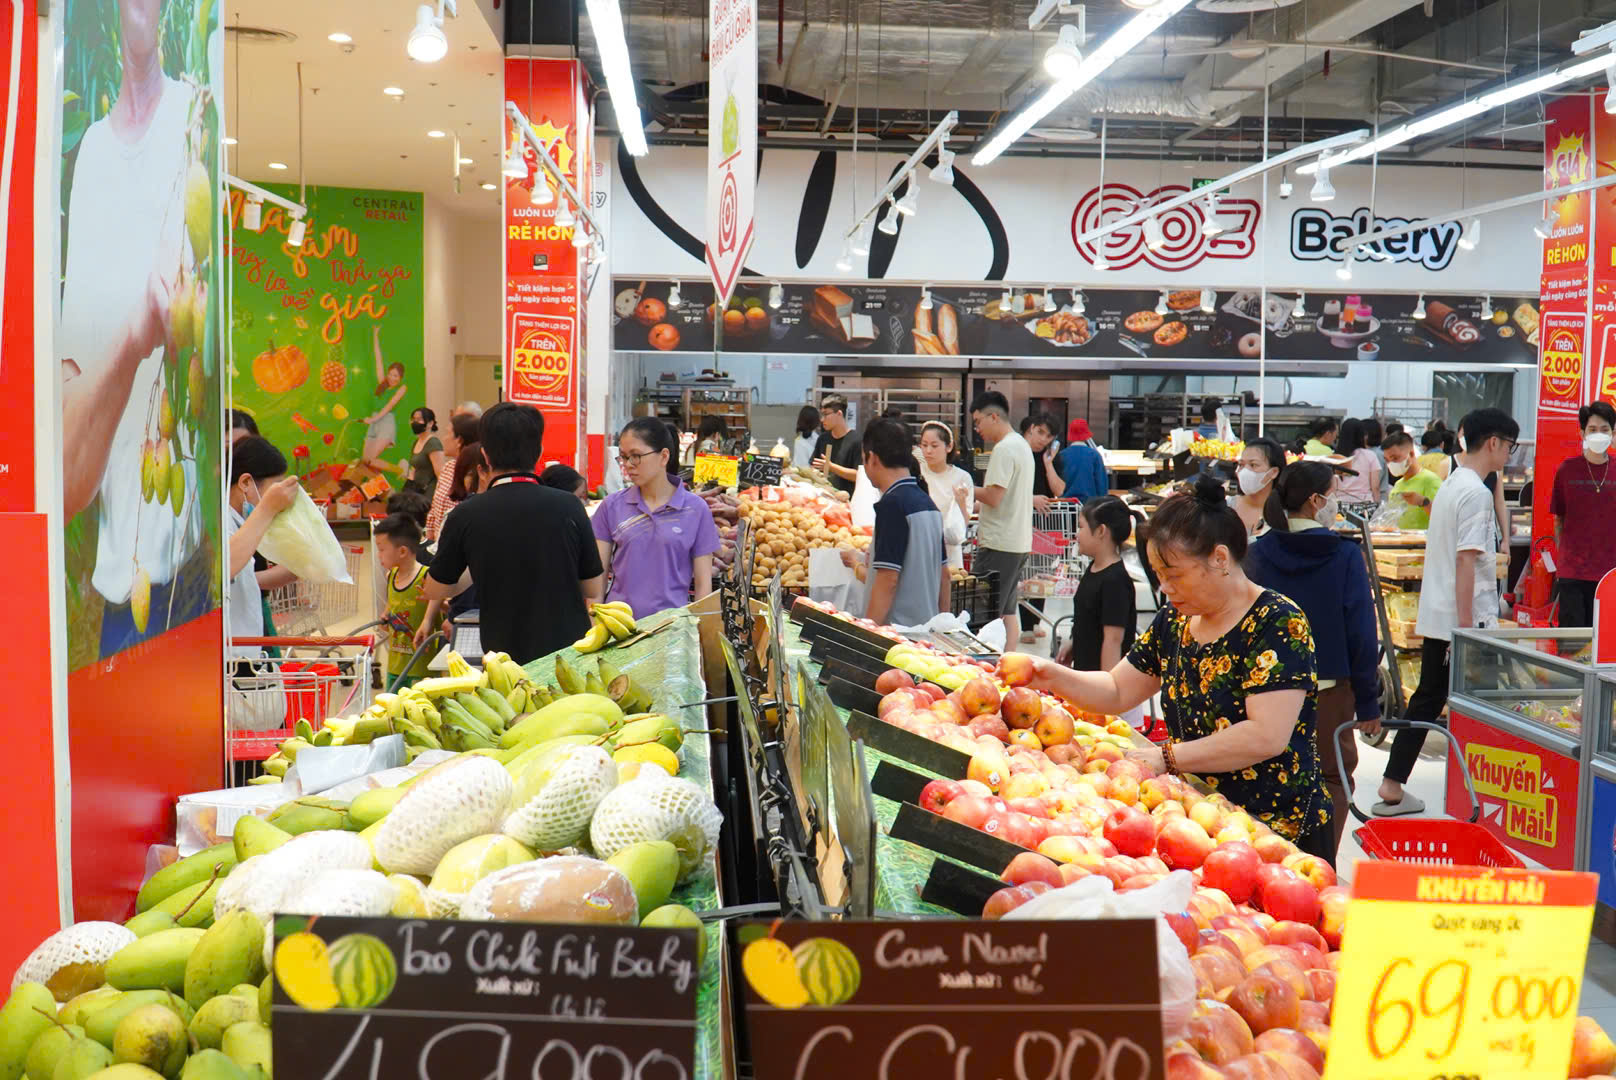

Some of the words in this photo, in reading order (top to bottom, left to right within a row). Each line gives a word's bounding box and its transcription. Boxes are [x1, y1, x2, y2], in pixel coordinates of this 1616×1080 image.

[352, 197, 417, 211] CENTRAL
[513, 207, 540, 217] LUÔN
[365, 209, 409, 222] RETAIL
[508, 219, 532, 240] RẺ
[534, 225, 575, 240] HƠN
[1295, 209, 1461, 267] Bakery
[1546, 241, 1561, 264] RẺ
[1562, 243, 1586, 263] HƠN
[319, 284, 388, 345] giá
[1595, 301, 1616, 313] mỗ
[530, 337, 556, 351] TRÊN
[1554, 337, 1574, 351] TRÊN
[516, 353, 567, 371] 2.000
[1543, 355, 1581, 375] 2.000
[1468, 752, 1537, 795] Khuyến
[1510, 797, 1555, 843] Mãi!
[1416, 868, 1504, 903] KHUYẾN
[874, 928, 949, 968] Cam
[1366, 956, 1576, 1062] 69.000
